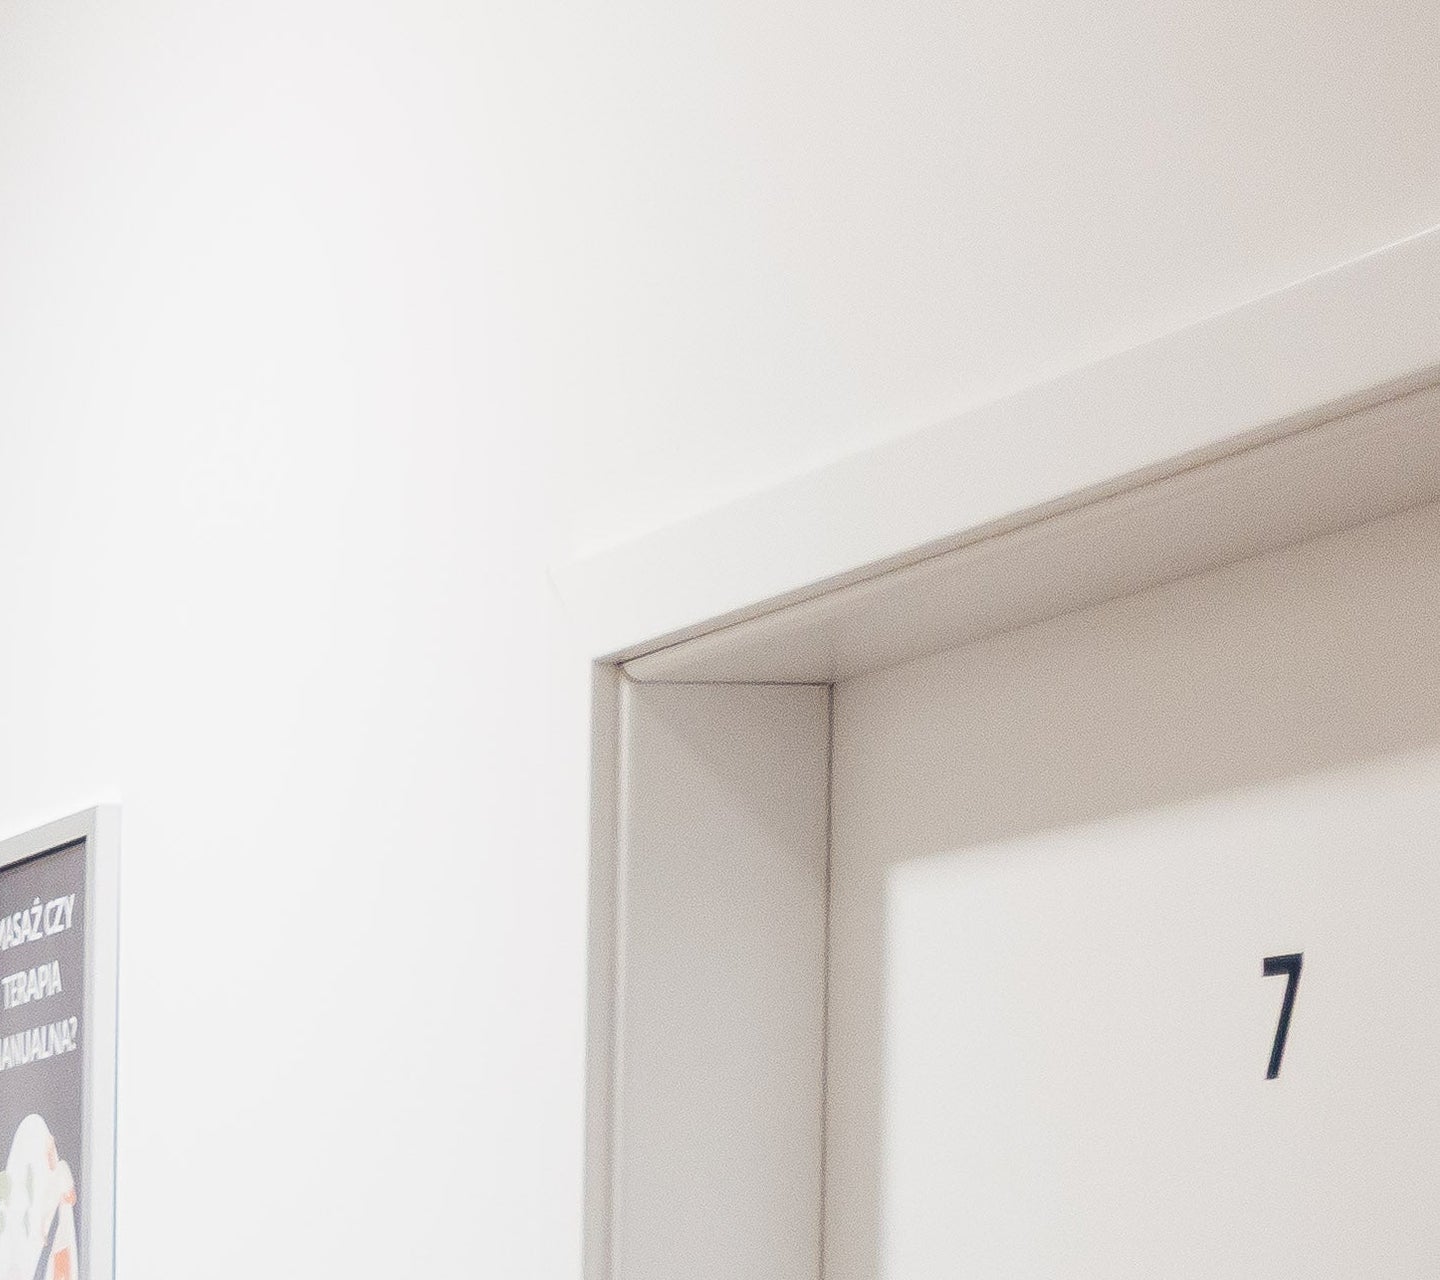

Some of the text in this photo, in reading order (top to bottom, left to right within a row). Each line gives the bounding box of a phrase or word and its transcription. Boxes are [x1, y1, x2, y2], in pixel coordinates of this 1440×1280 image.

[44, 893, 76, 936] CZY
[1, 960, 63, 1010] TERAPIA
[1262, 952, 1304, 1080] 7
